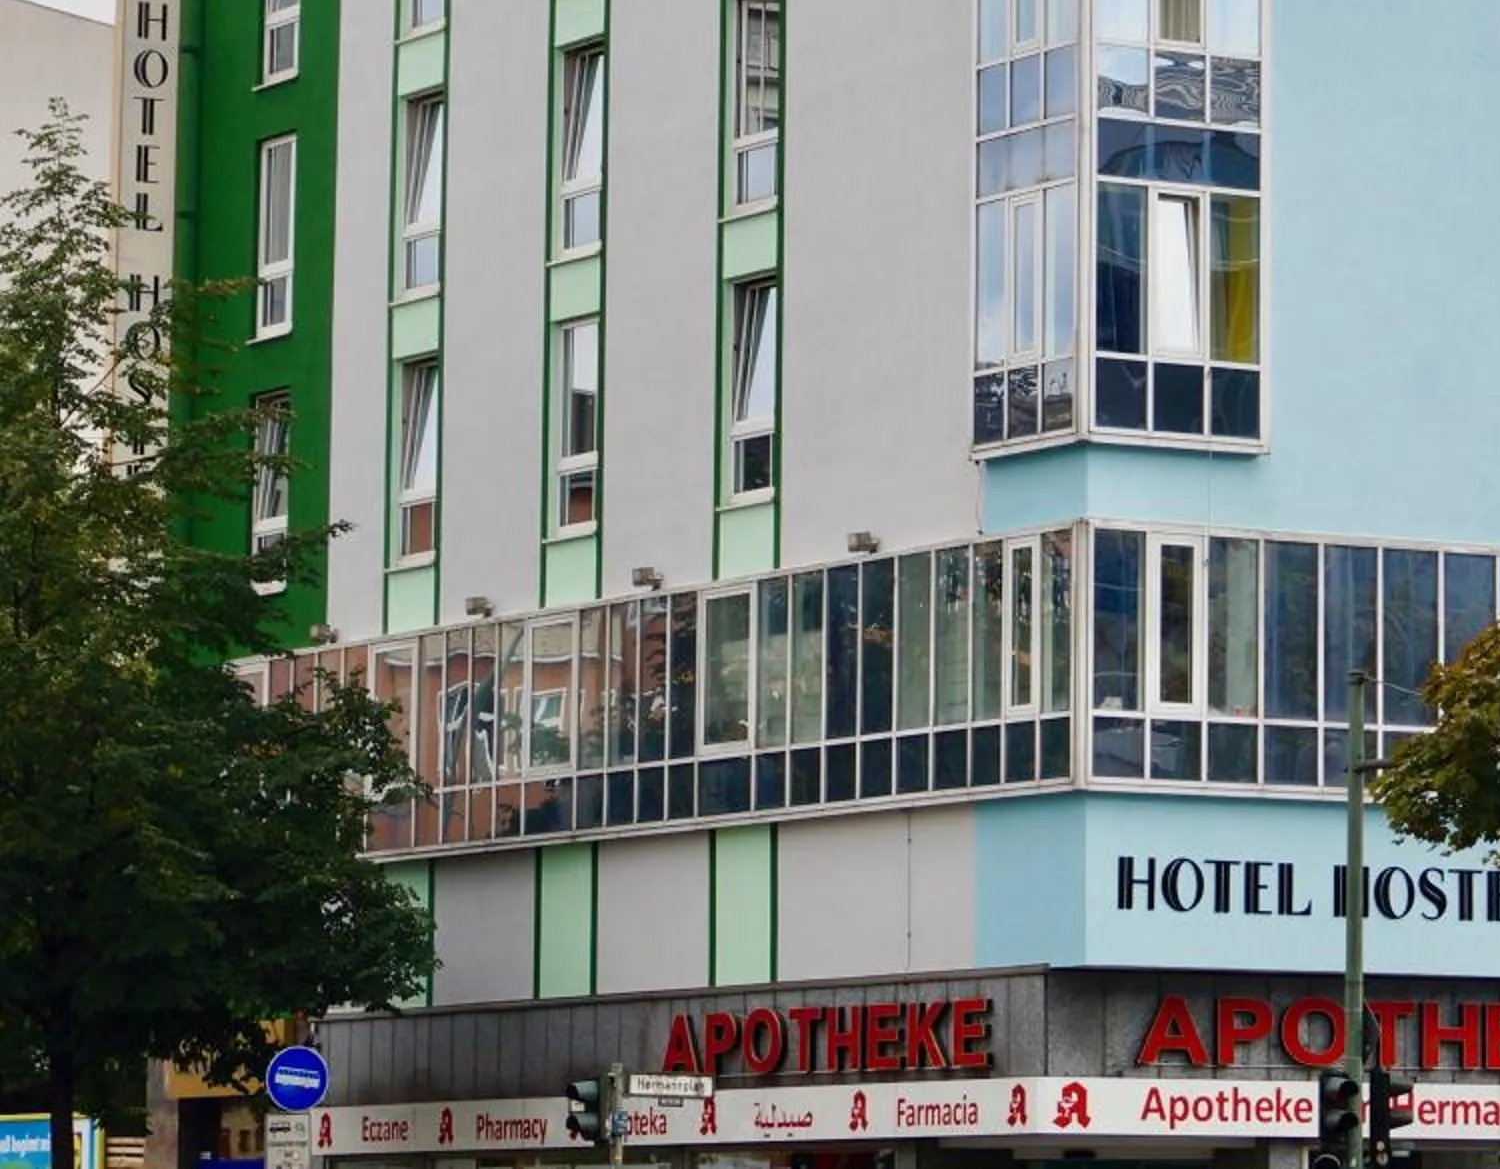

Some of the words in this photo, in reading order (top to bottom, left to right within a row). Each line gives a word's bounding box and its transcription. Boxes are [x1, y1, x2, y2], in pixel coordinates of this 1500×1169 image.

[133, 1, 169, 232] HOTEL
[1116, 856, 1313, 916] HOTEL
[662, 998, 989, 1074] APOTHEKE
[624, 1106, 668, 1144] pteka
[897, 1095, 979, 1128] Farmacia
[1140, 1085, 1313, 1129] Apotheke
[361, 1116, 409, 1142] Eczane
[476, 1114, 548, 1144] Pharmacy
